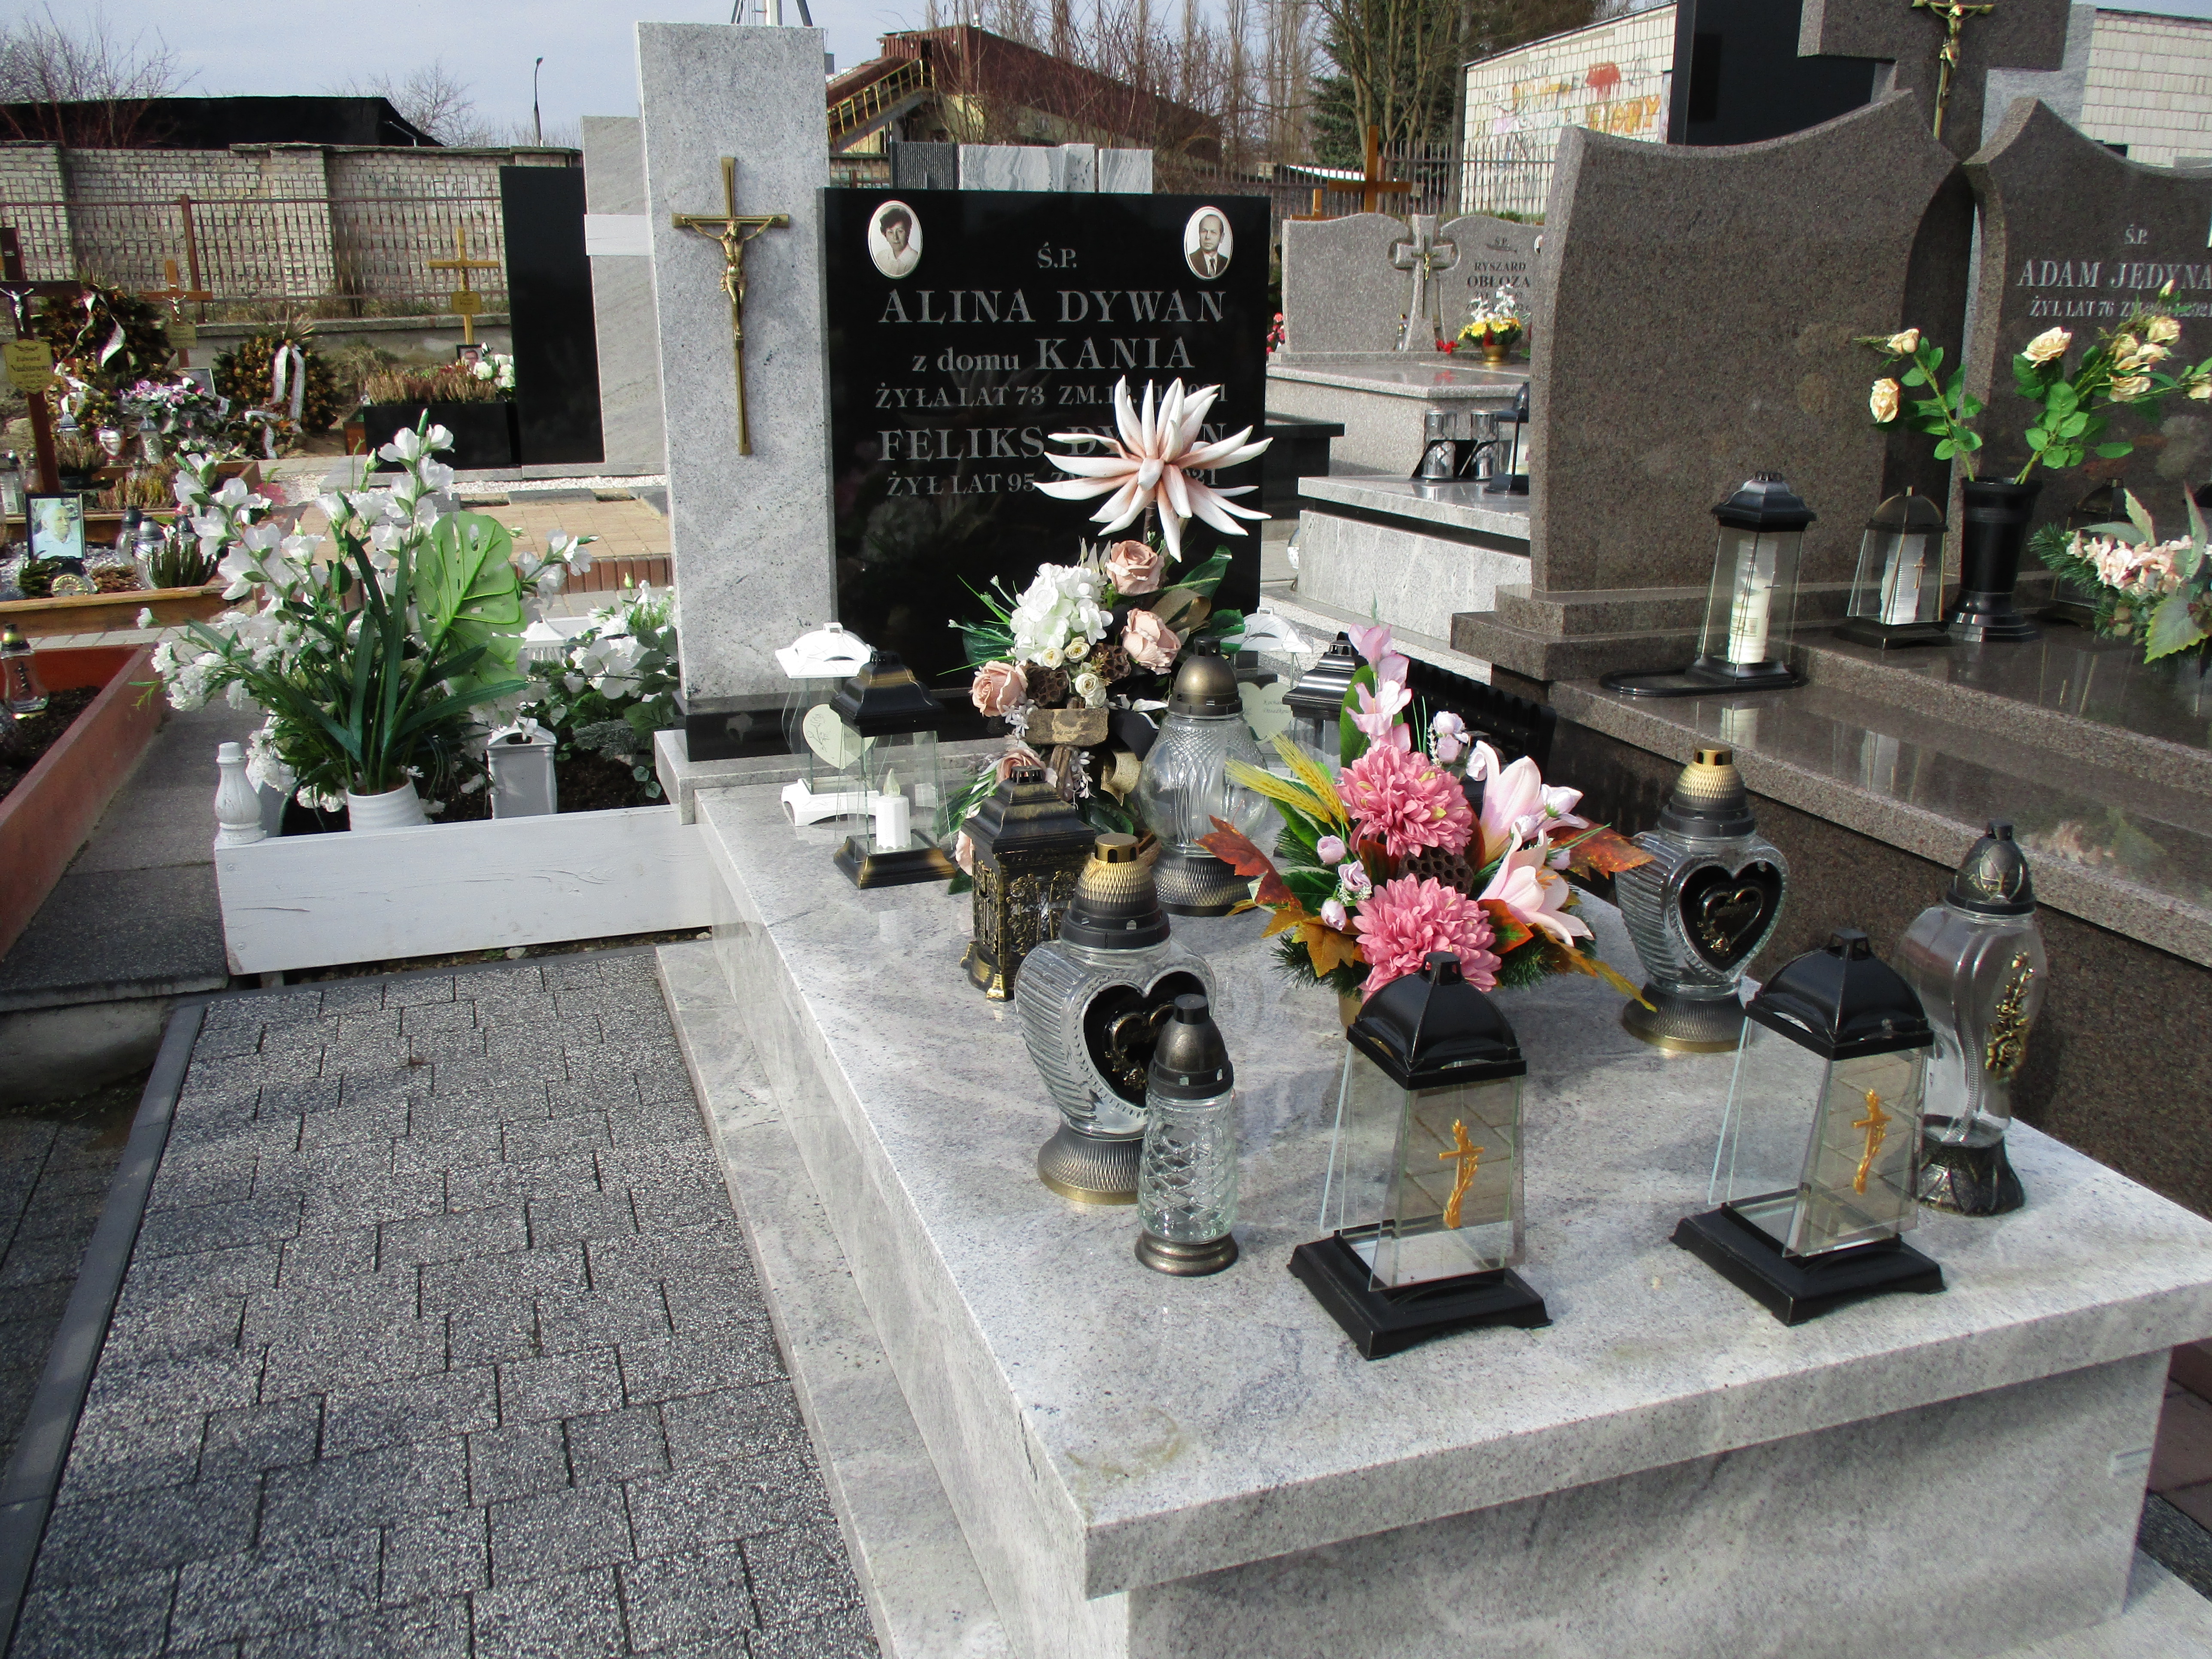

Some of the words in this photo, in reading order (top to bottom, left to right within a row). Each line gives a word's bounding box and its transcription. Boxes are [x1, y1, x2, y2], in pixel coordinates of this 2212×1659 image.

[1037, 242, 1077, 269] Ś.P.
[1474, 261, 1527, 271] RYSZARD
[2017, 259, 2103, 288] ADAM
[878, 288, 1036, 325] ALINA
[1057, 289, 1226, 323] DYWAN
[2065, 301, 2097, 317] LAT
[2098, 301, 2114, 317] 76
[912, 355, 927, 373] z
[937, 346, 1021, 371] domu
[1034, 336, 1196, 370] KANIA
[875, 382, 951, 409] ŻYŁA
[957, 386, 1010, 407] LAT
[1015, 385, 1045, 406] 73
[877, 425, 1045, 462] FELIKS
[1066, 423, 1228, 455] DYN
[887, 470, 944, 497] ŻYŁ
[951, 473, 1003, 495] LAT
[1007, 473, 1044, 493] 95
